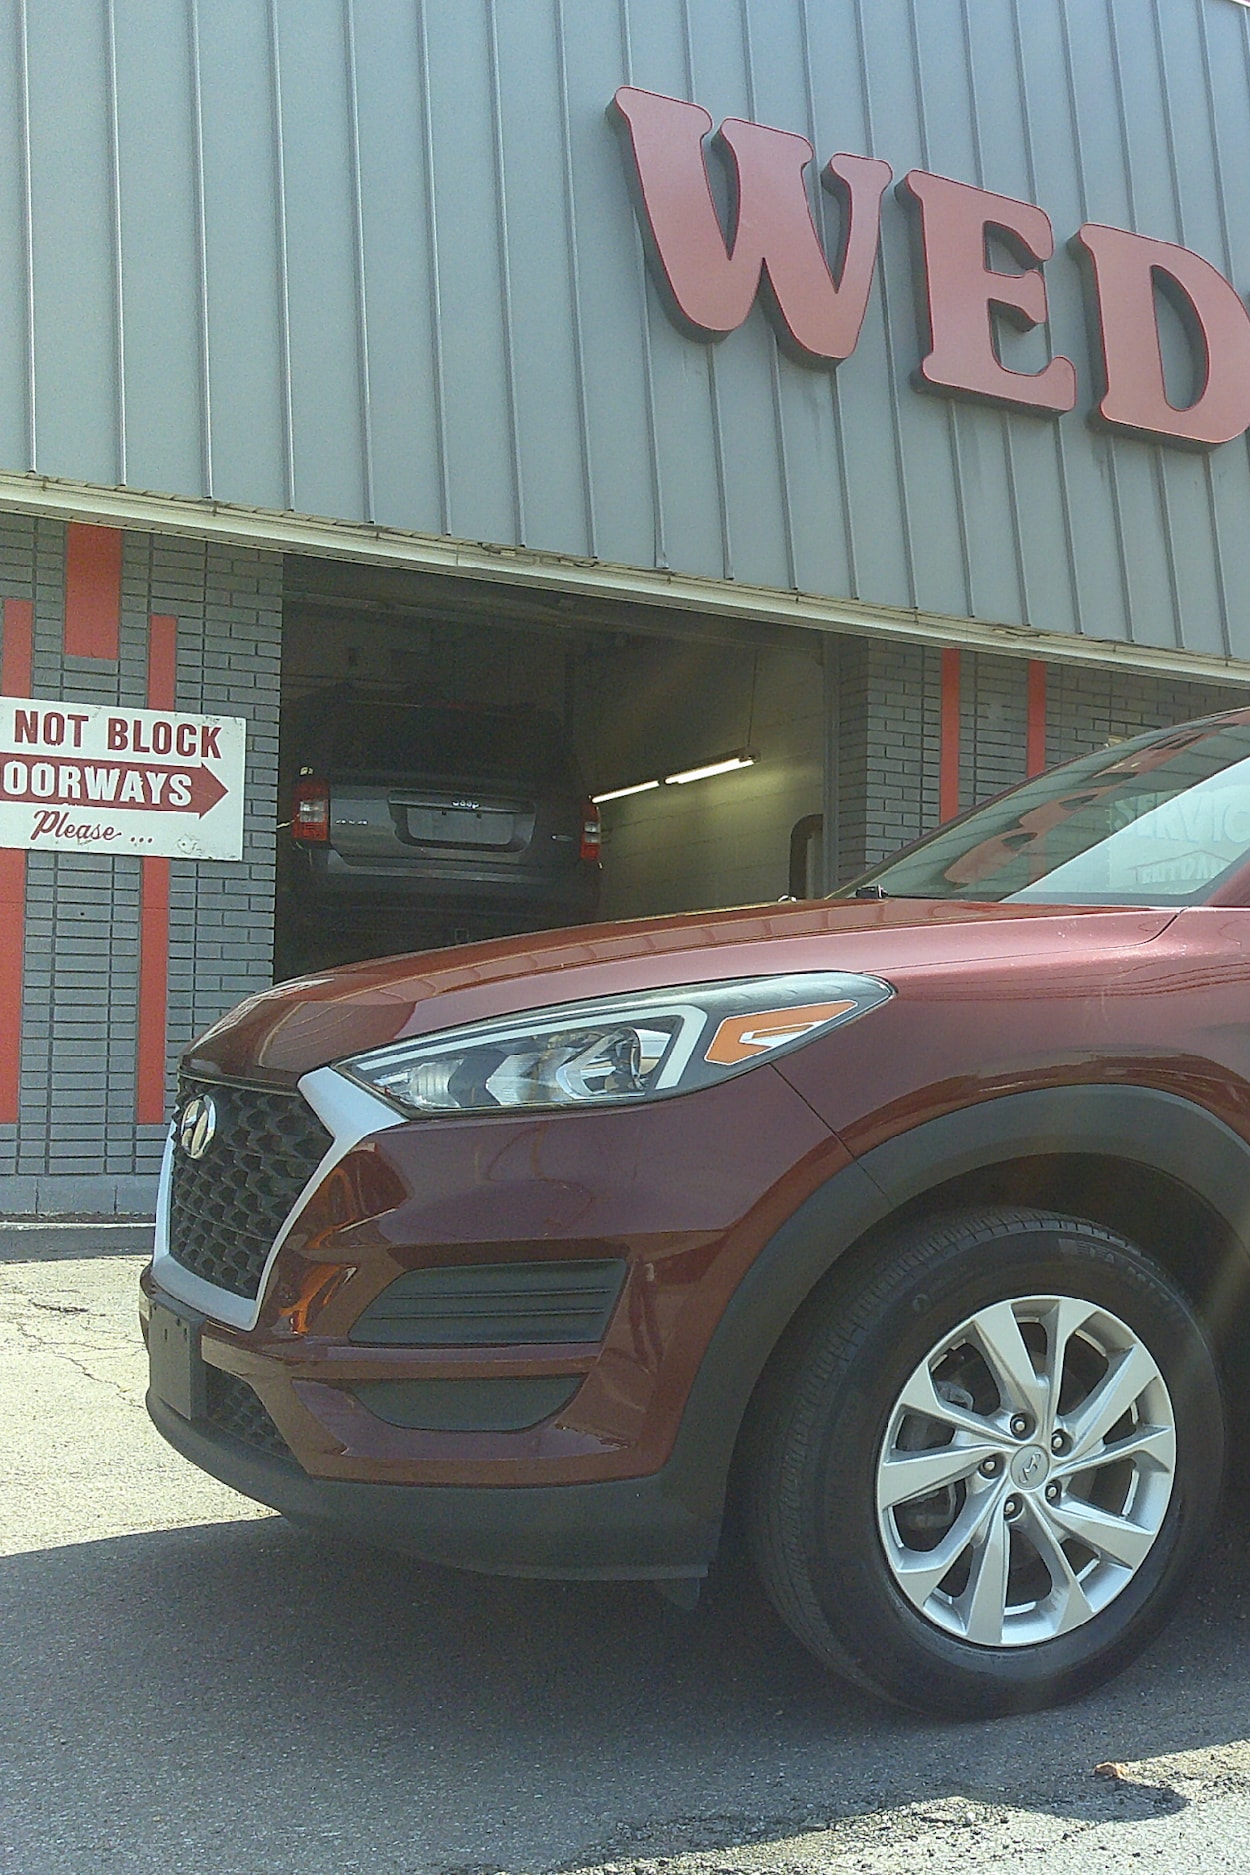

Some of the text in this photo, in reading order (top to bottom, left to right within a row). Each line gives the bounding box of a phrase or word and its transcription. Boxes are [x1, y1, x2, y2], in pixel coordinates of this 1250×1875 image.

[15, 709, 222, 759] NOT BLOCK
[30, 810, 122, 841] Please
